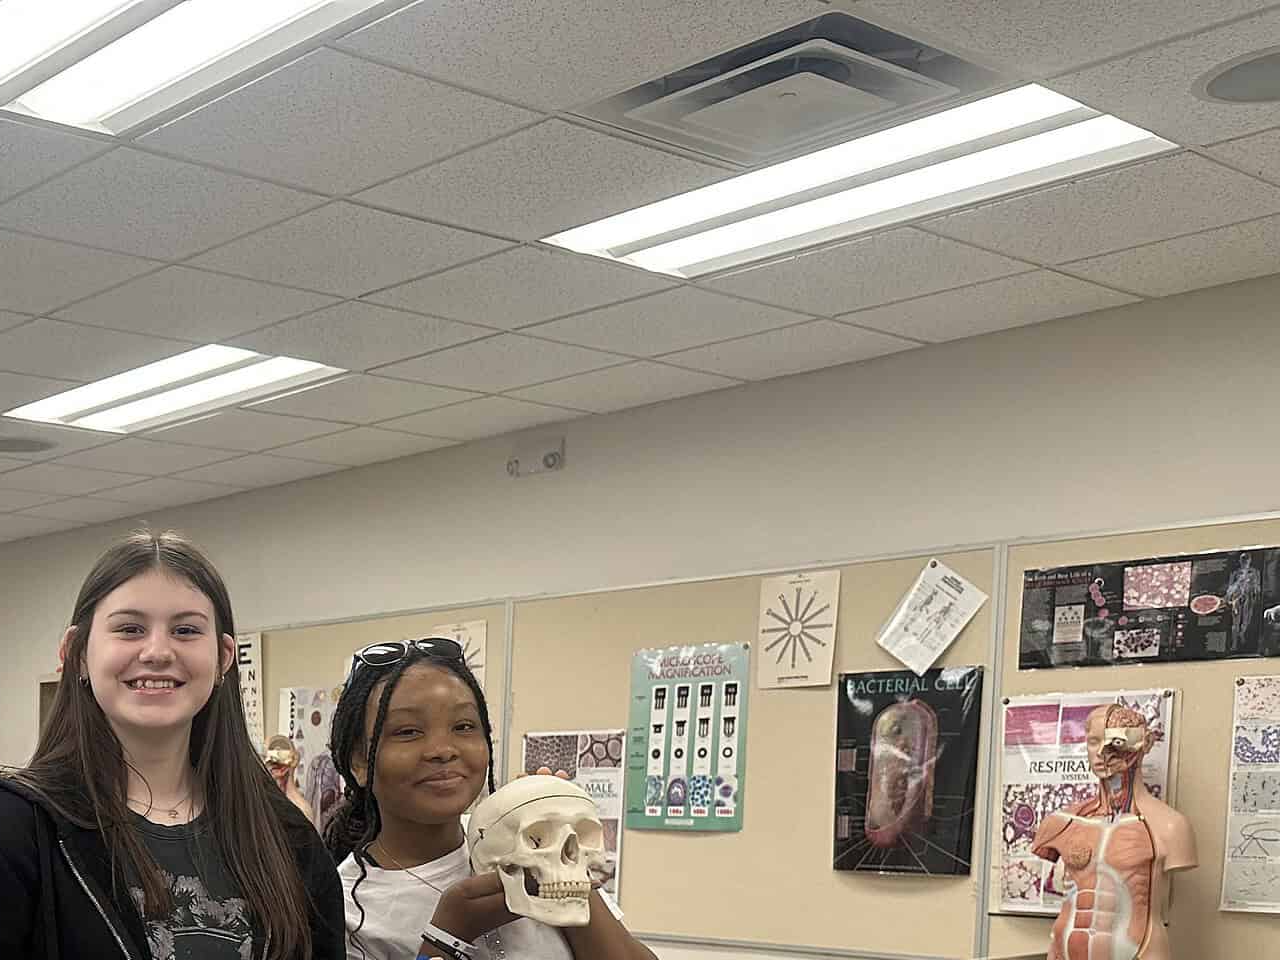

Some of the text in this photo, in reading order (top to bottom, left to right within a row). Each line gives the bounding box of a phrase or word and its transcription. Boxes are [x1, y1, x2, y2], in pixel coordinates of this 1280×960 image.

[648, 664, 732, 680] MAGNIFICATION
[846, 678, 929, 695] BACTERIAL
[1061, 773, 1090, 782] SYSTEM
[585, 783, 614, 793] MALE
